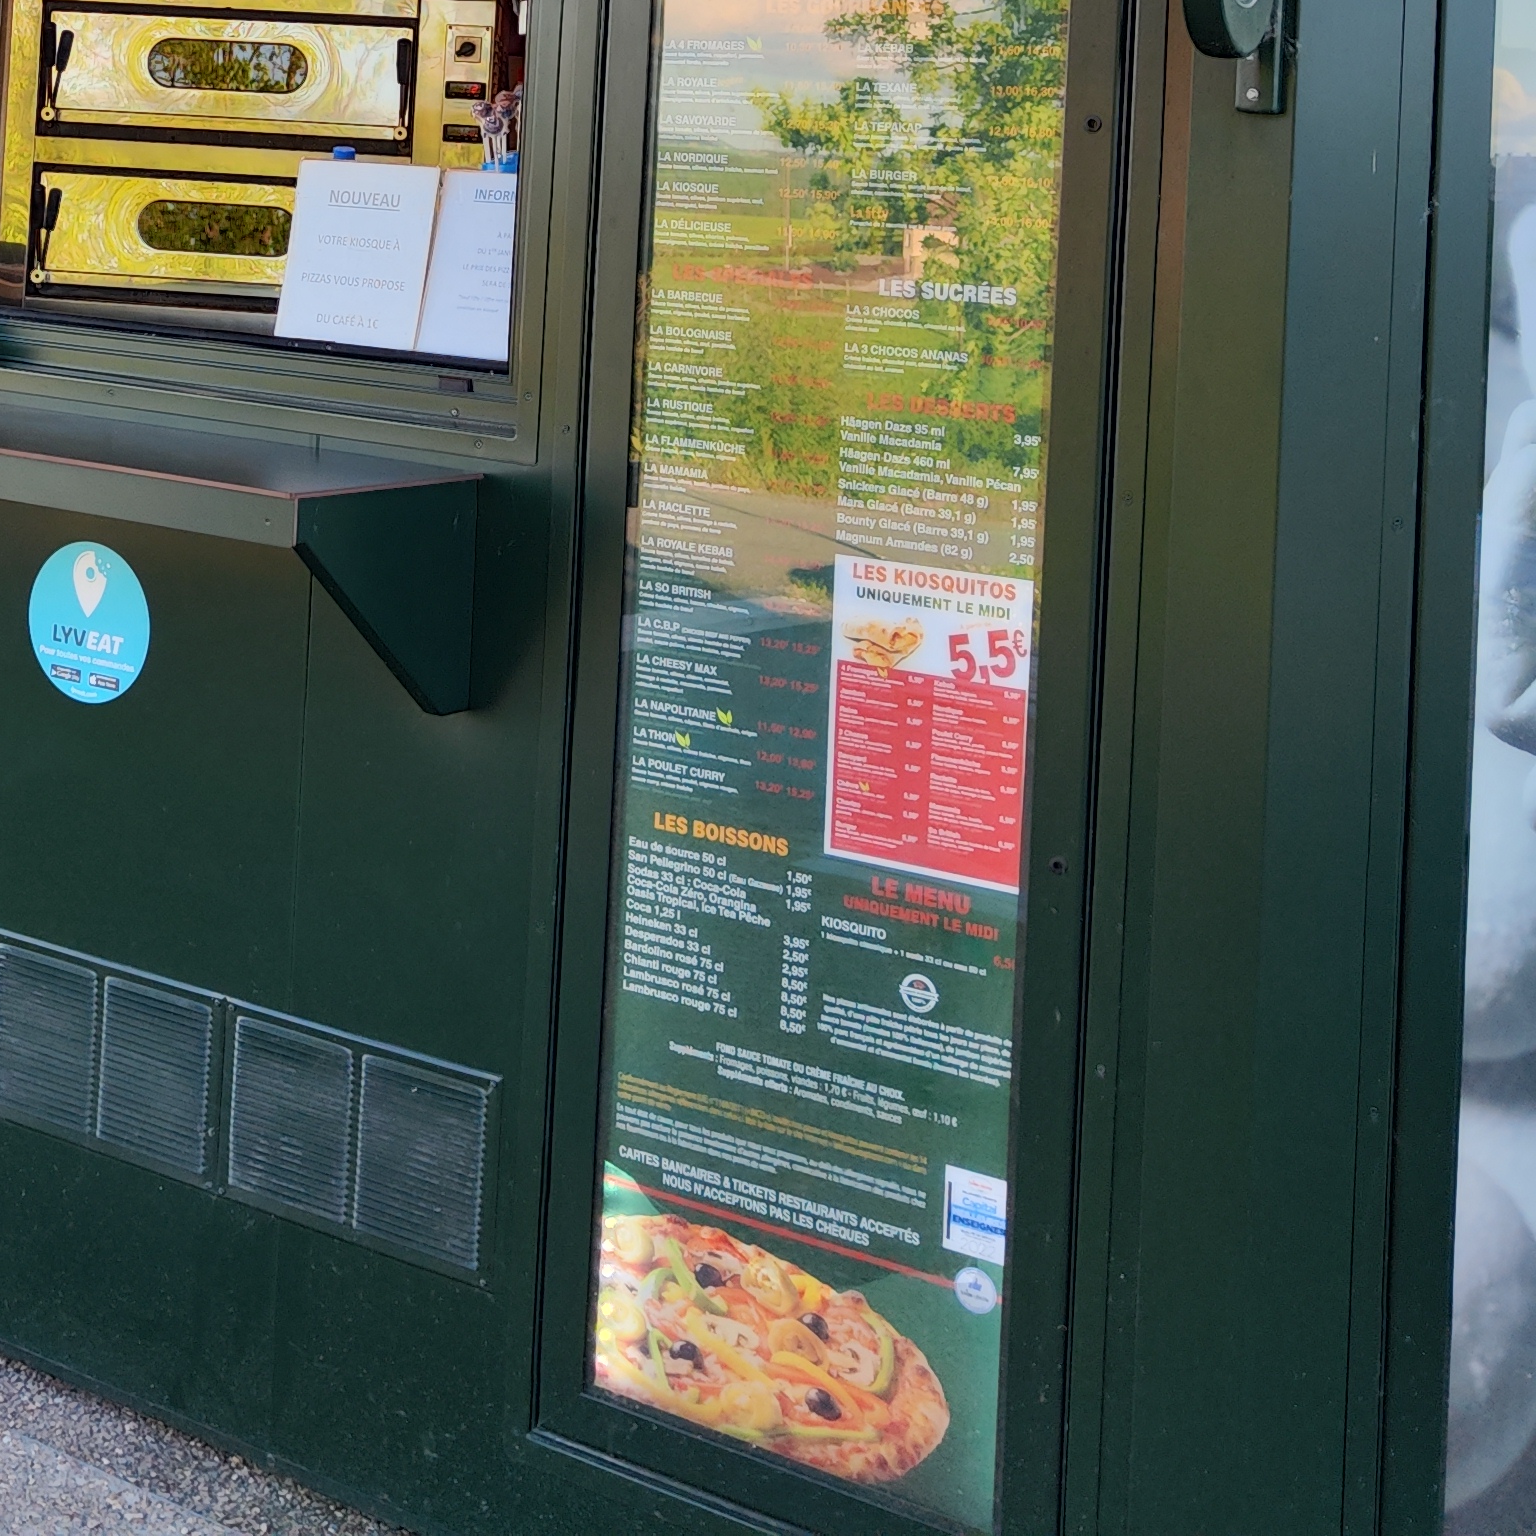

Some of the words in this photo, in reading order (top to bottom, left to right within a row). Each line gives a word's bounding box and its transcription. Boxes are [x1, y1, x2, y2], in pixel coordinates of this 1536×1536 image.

[329, 190, 401, 209] NOUVEAU
[657, 181, 670, 191] LA
[672, 182, 719, 194] KIOSQUE
[318, 235, 347, 246] VOTRE
[350, 238, 391, 250] KIOSQUE
[393, 238, 400, 251] À
[301, 272, 331, 284] PIZZAS
[334, 275, 359, 287] VOUS
[362, 278, 405, 291] PROPOSE
[878, 278, 916, 297] LES
[921, 281, 1016, 306] SUCRÉES
[317, 313, 330, 323] DU
[333, 313, 355, 326] CAFÉ
[358, 314, 364, 326] À
[367, 319, 378, 329] 1€
[867, 393, 903, 411] LES
[910, 396, 1016, 424] DESSERTS
[841, 430, 876, 444] Vanille
[878, 434, 942, 451] Macadamia
[837, 495, 864, 508] Mars
[867, 498, 898, 514] Glacé
[901, 504, 935, 520] (Barre
[938, 508, 961, 522] 39,1
[964, 512, 976, 525] g)
[642, 536, 655, 546] LA
[657, 537, 696, 553] ROYALE
[698, 543, 733, 558] KEBAB
[853, 562, 887, 582] LES
[894, 568, 1017, 601] KIOSQUITOS
[857, 586, 951, 611] UNIQUEMENT
[957, 601, 973, 614] LE
[978, 604, 1010, 620] MIDI
[53, 624, 124, 654] LYVEAT
[635, 698, 648, 708] LA
[650, 700, 716, 722] NAPOLITAINE
[632, 756, 646, 766] LA
[648, 758, 688, 776] POULET
[690, 764, 725, 782] CURRY
[654, 812, 688, 834] LES
[693, 820, 789, 856] BOISSONS
[872, 876, 898, 899] LE
[905, 882, 971, 915] MENU
[821, 916, 887, 940] KIOSQUITO
[843, 895, 939, 927] UNIQUEMENT
[943, 917, 961, 932] LE
[966, 922, 1000, 941] MIDI
[625, 925, 684, 948] Desperados
[687, 940, 699, 951] 33
[702, 943, 710, 955] cl
[619, 1145, 659, 1167] CARTES
[662, 1157, 721, 1185] BANCAIRES
[723, 1176, 730, 1188] &
[732, 1178, 776, 1203] TICKETS
[778, 1192, 859, 1227] RESTAURANTS
[860, 1218, 920, 1246] ACCEPTÉS
[962, 1197, 997, 1214] Capital
[662, 1173, 692, 1192] NOUS
[694, 1183, 767, 1214] N'ACCEPTONS
[770, 1206, 791, 1221] PAS
[793, 1213, 813, 1229] LES
[816, 1216, 870, 1246] CHÈQUES
[953, 1214, 1006, 1236] ENSEIGNES
